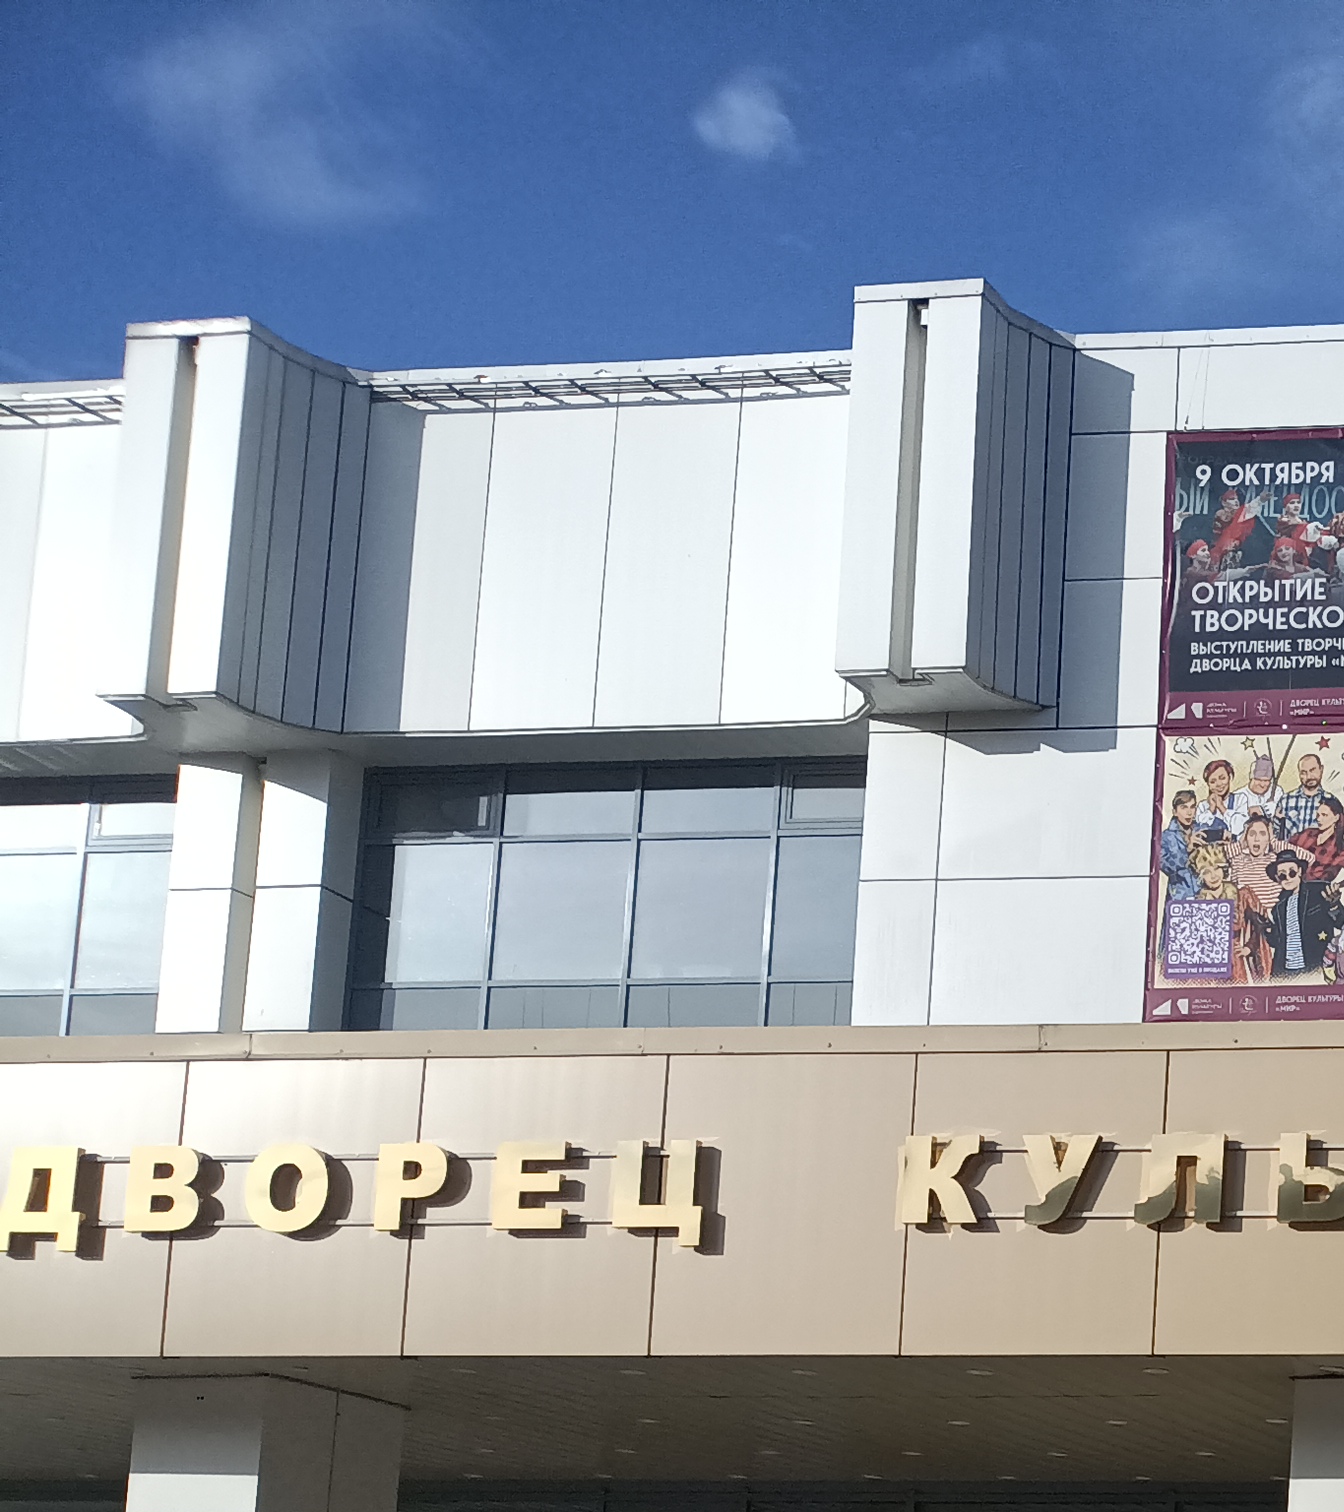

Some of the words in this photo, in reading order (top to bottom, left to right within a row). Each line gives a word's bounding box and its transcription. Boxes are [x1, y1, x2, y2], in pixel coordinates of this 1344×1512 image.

[1195, 465, 1211, 487] 9
[1221, 460, 1335, 486] ОКТЯБРЯ
[1191, 578, 1327, 604] ОТКРЫТИЕ
[1190, 639, 1292, 656] ВЫСТУПЛЕНИЕ
[1190, 657, 1251, 673] ДВОРЦА
[1256, 655, 1327, 670] КУЛЬТУРЫ
[0, 1140, 703, 1252] ДВОРЕЦ
